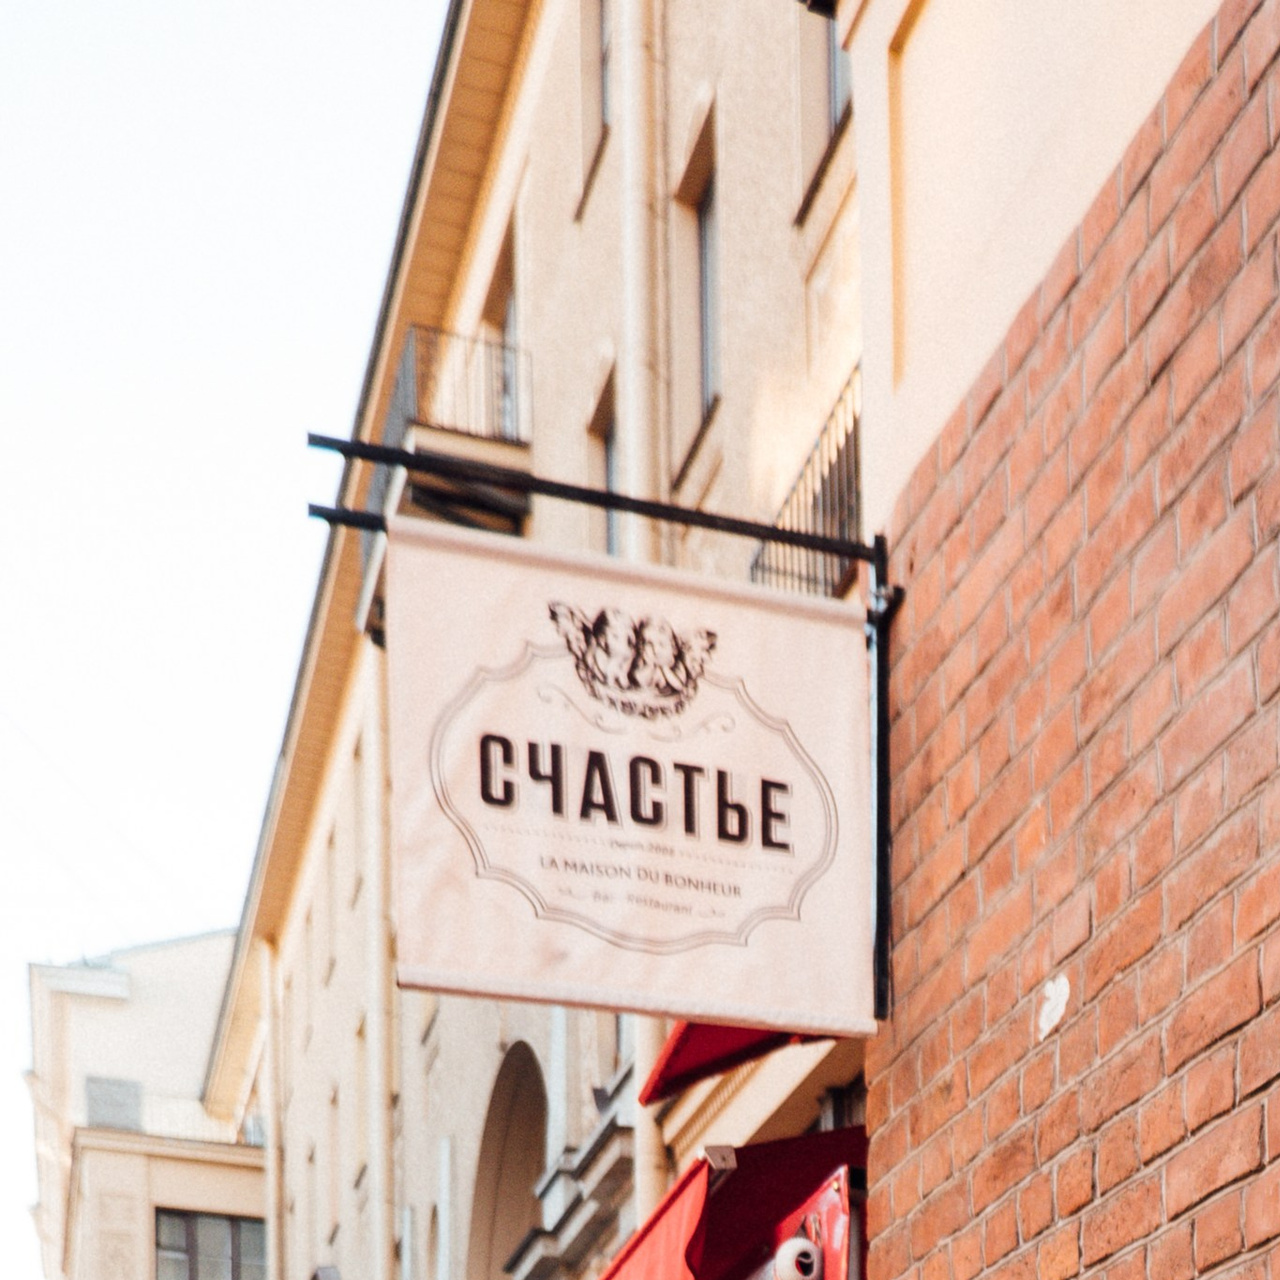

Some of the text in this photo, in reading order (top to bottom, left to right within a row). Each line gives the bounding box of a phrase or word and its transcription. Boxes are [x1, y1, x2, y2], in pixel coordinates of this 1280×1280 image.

[479, 733, 794, 851] СЧАСТЬЕ
[539, 856, 742, 898] LA MAISON DU BONHEUR
